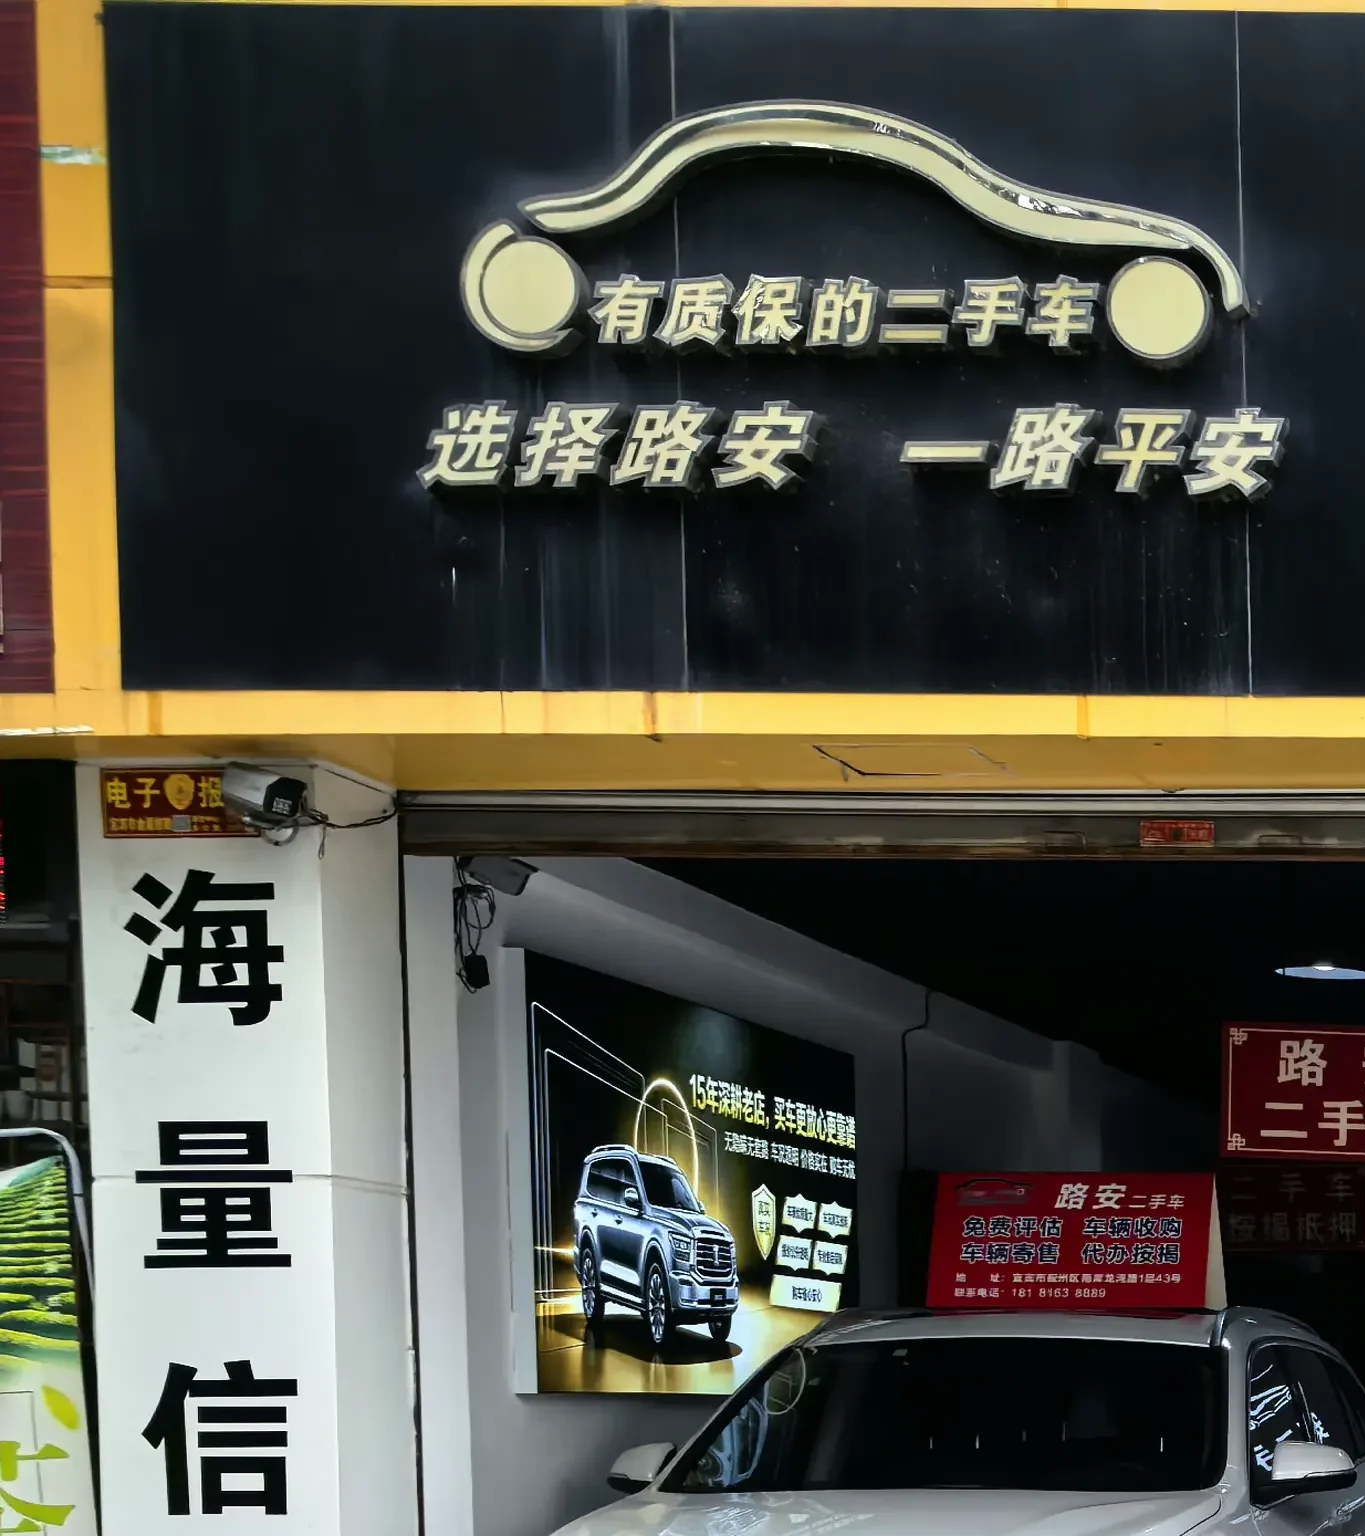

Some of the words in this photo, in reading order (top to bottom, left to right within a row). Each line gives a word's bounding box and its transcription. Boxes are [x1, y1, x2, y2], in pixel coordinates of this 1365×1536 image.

[588, 273, 1100, 347] 有质保的二手车
[416, 400, 816, 490] 选择路安
[900, 402, 1286, 498] 一路平安
[106, 777, 160, 809] 电子
[1055, 1183, 1127, 1210] 路安
[1129, 1195, 1185, 1210] 二手车
[962, 1215, 1063, 1239] 免费评估
[1082, 1215, 1182, 1239] 车辆收购
[960, 1242, 1060, 1265] 车辆寄售
[1080, 1242, 1181, 1265] 代办按揭
[1012, 1288, 1032, 1298] 181
